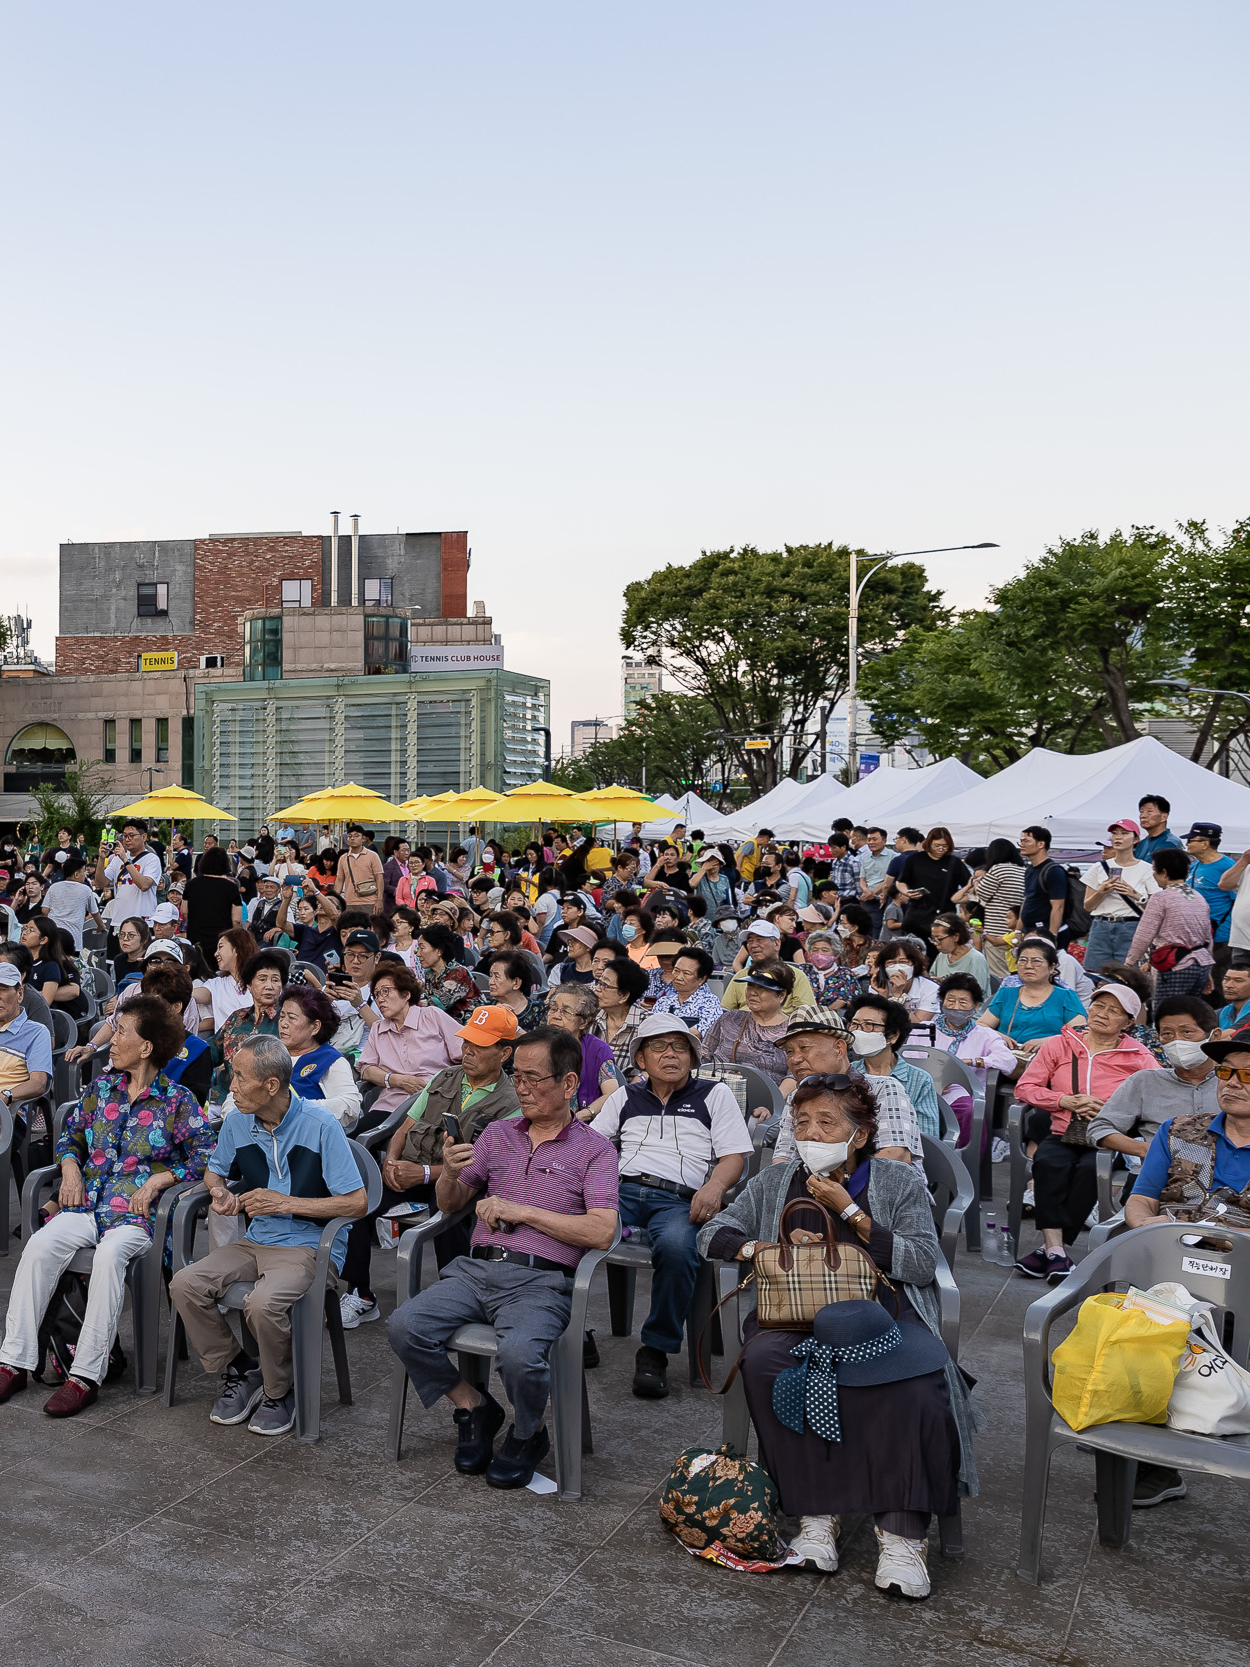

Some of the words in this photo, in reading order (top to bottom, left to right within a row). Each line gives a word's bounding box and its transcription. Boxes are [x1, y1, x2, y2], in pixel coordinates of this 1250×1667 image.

[143, 656, 175, 666] TENNIS
[419, 655, 449, 663] TENNIS
[473, 654, 501, 662] HOUSE
[473, 1009, 489, 1025] B
